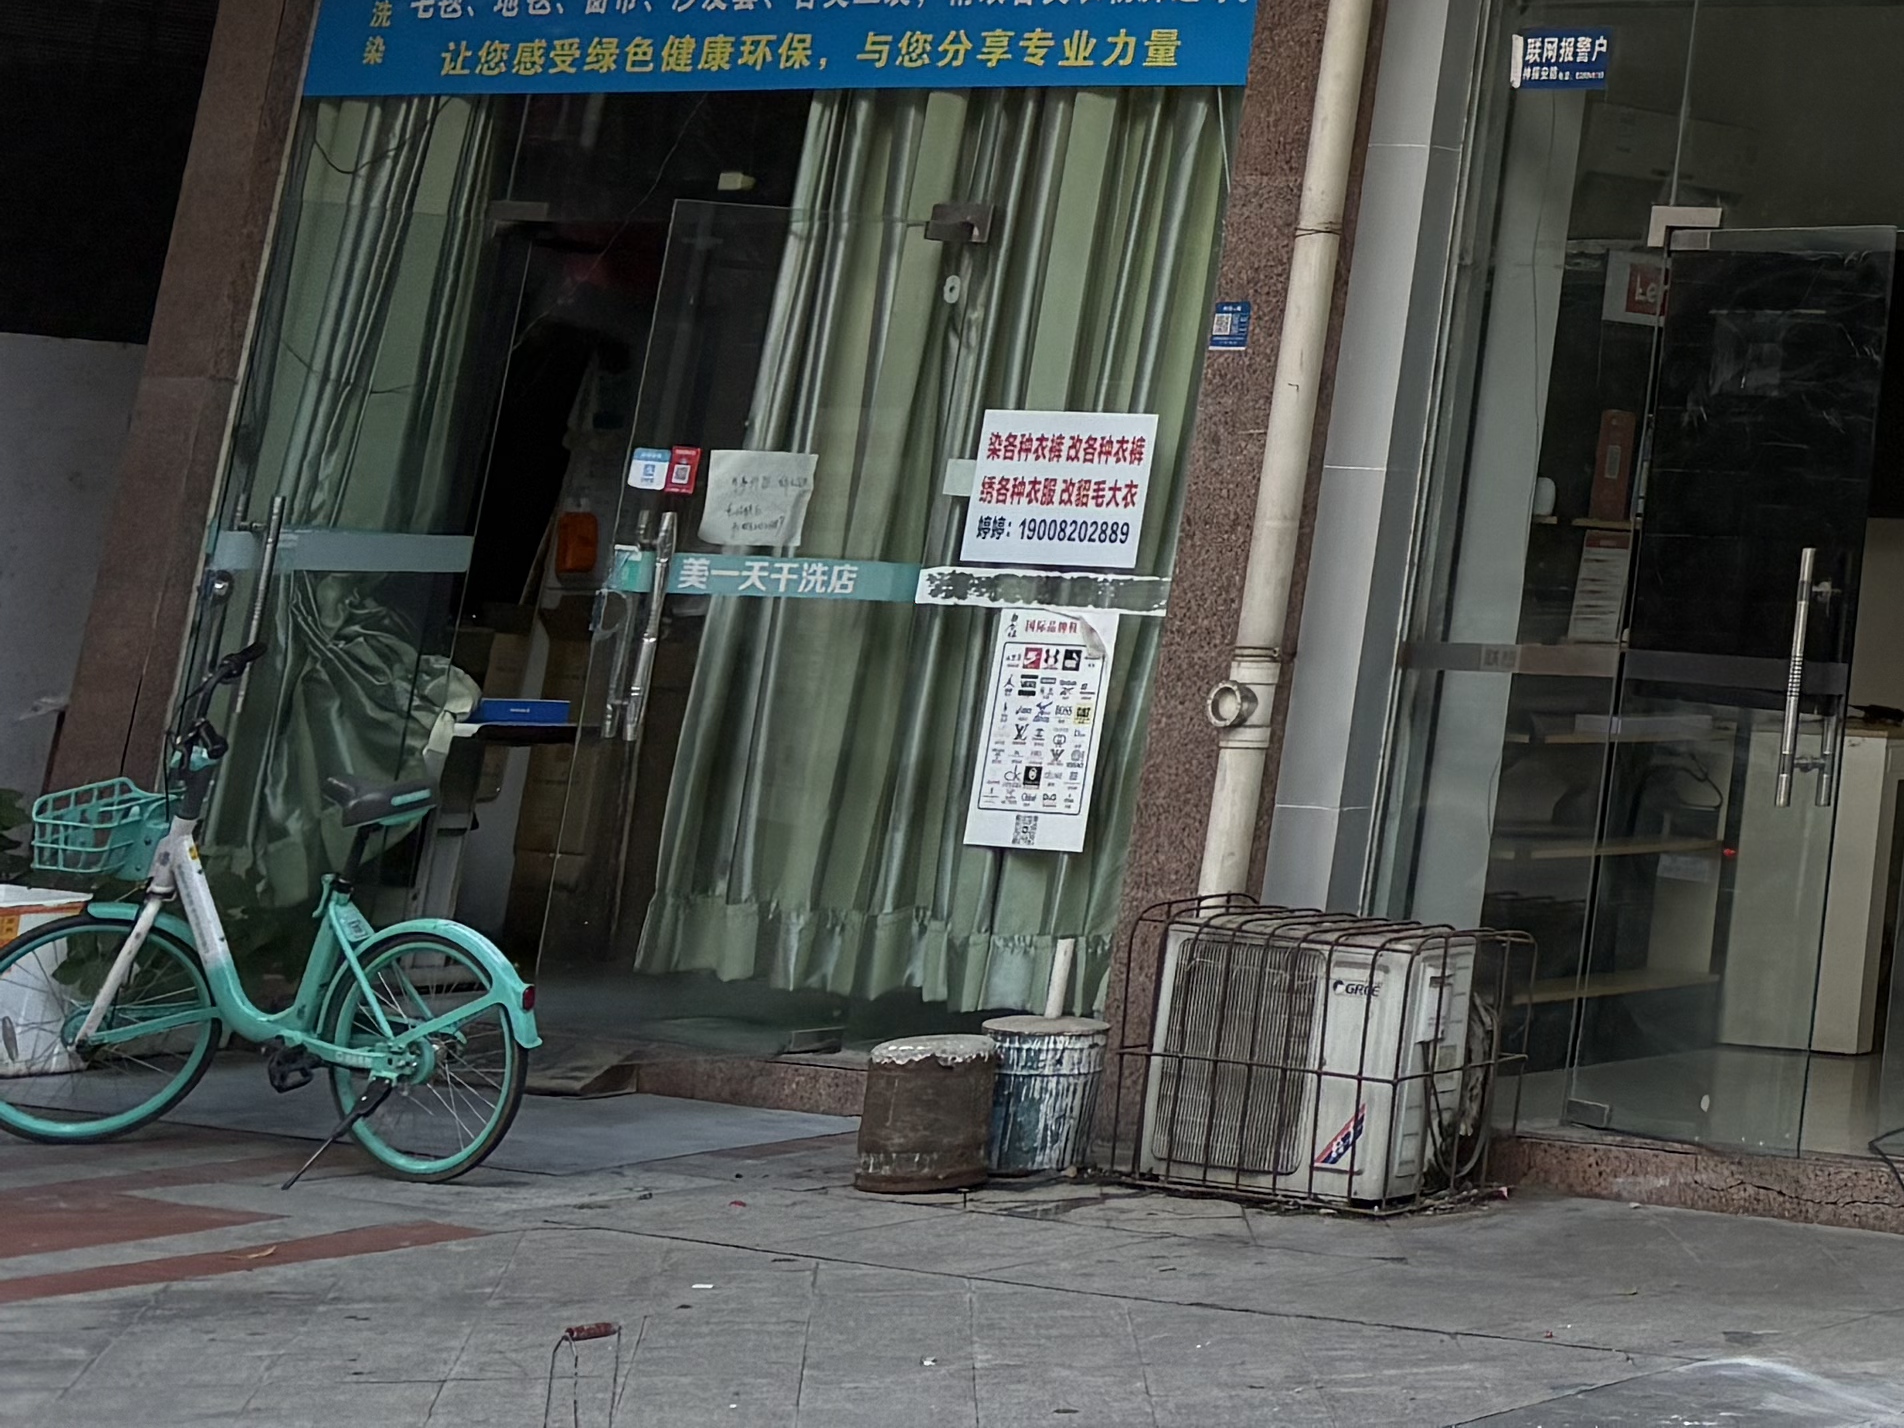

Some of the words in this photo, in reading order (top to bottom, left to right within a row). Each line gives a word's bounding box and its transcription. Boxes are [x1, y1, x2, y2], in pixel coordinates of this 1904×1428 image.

[986, 432, 1065, 464] 染各种衣裤
[1066, 434, 1146, 466] 改各种衣裤
[978, 475, 1057, 506] 绣各种衣服
[677, 557, 859, 594] 美一天干洗店
